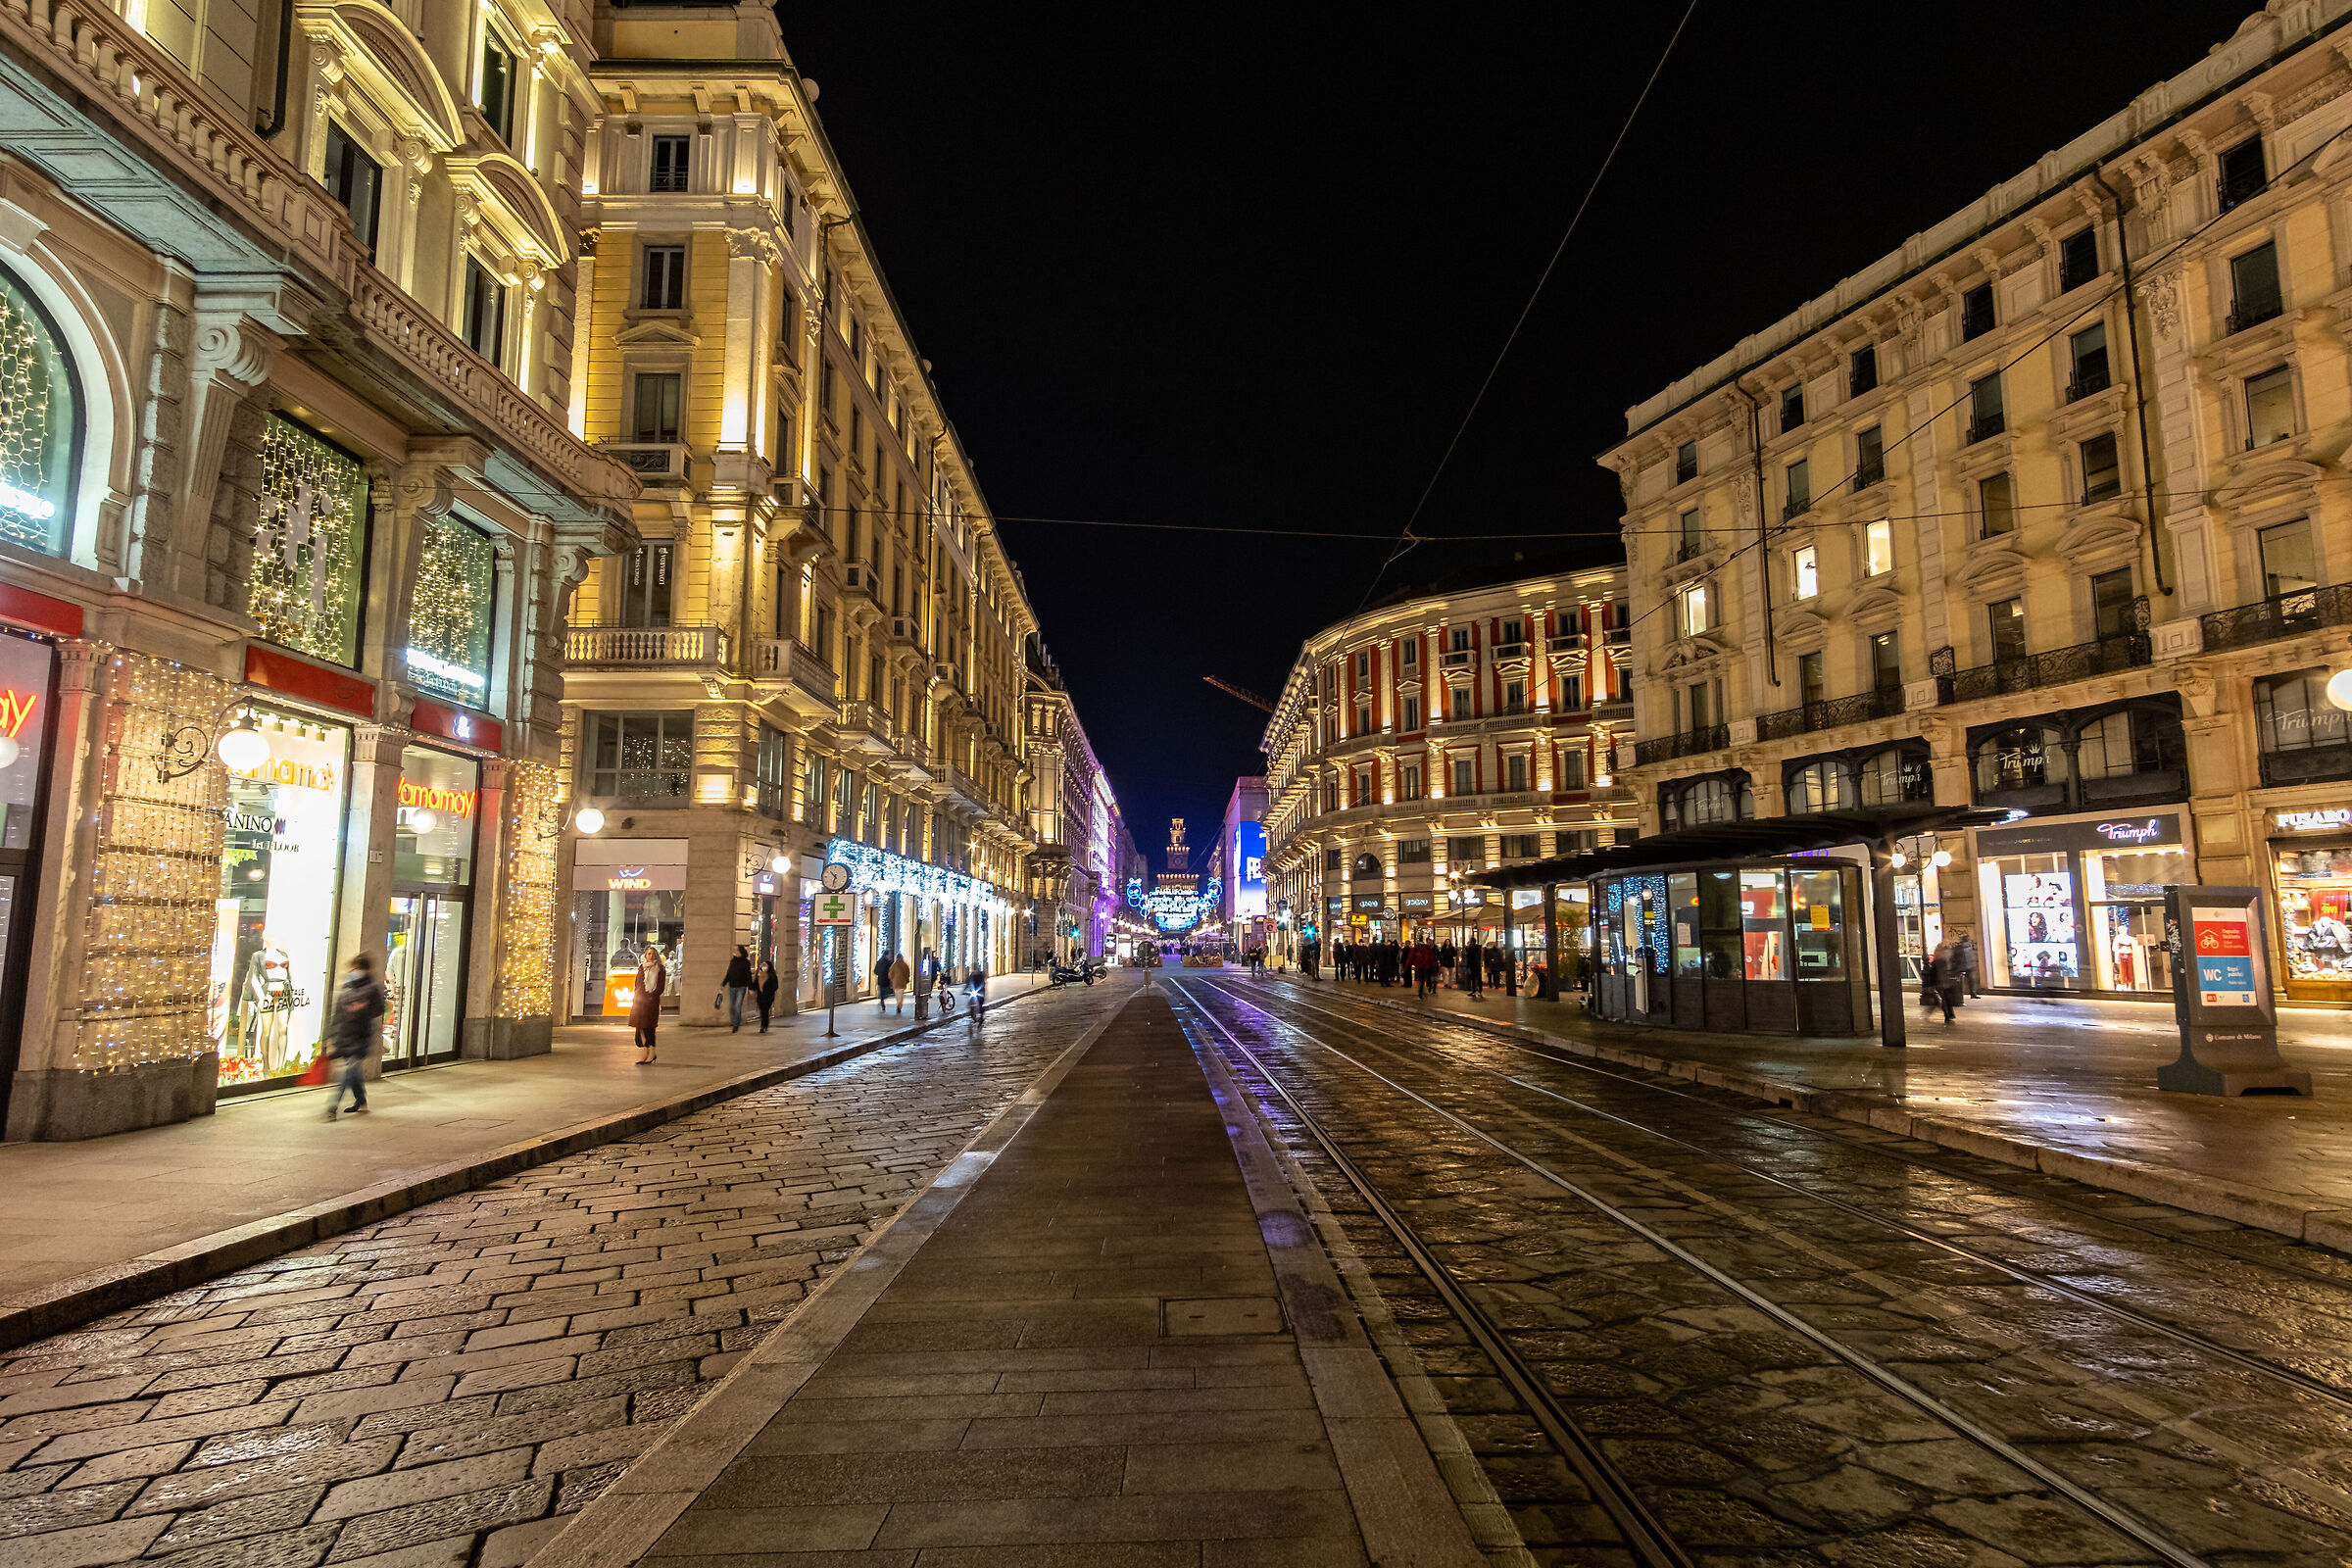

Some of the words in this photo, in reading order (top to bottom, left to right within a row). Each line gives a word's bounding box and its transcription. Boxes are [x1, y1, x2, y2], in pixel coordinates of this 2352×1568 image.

[2096, 819, 2158, 844] Triumph
[608, 878, 652, 889] WIND
[2203, 969, 2223, 981] WC
